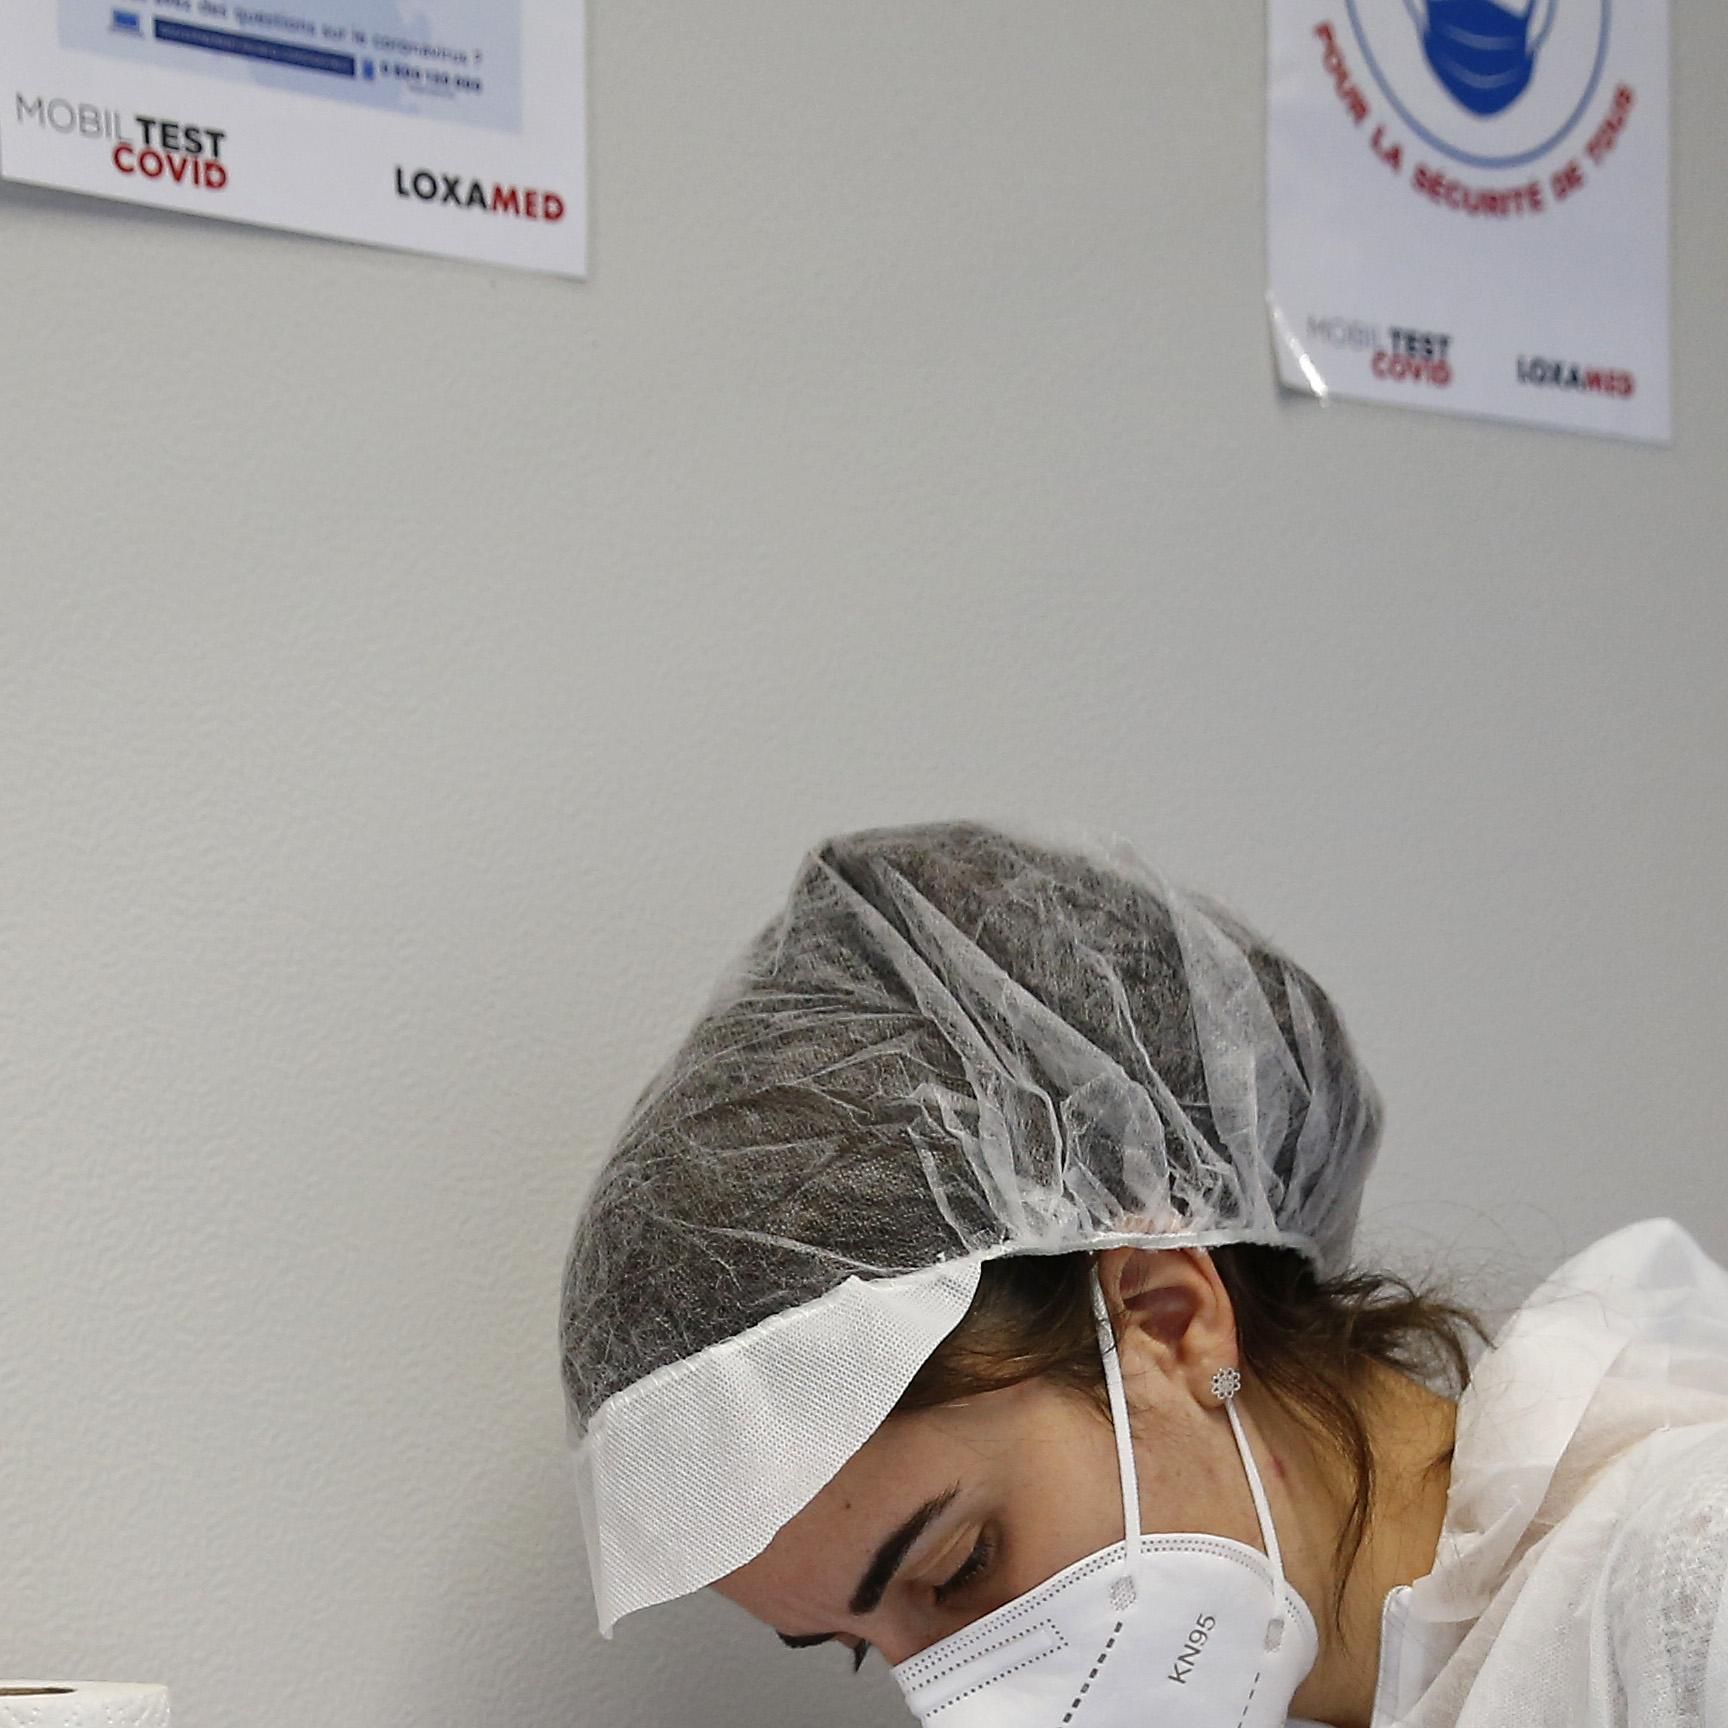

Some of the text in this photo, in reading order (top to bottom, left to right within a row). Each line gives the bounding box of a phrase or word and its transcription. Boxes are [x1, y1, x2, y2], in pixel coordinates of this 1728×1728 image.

[113, 142, 229, 190] COVID
[1371, 124, 1404, 172] LA
[395, 166, 566, 224] LOXAMED
[1372, 350, 1454, 388] COVID
[1167, 1612, 1218, 1685] KN95
